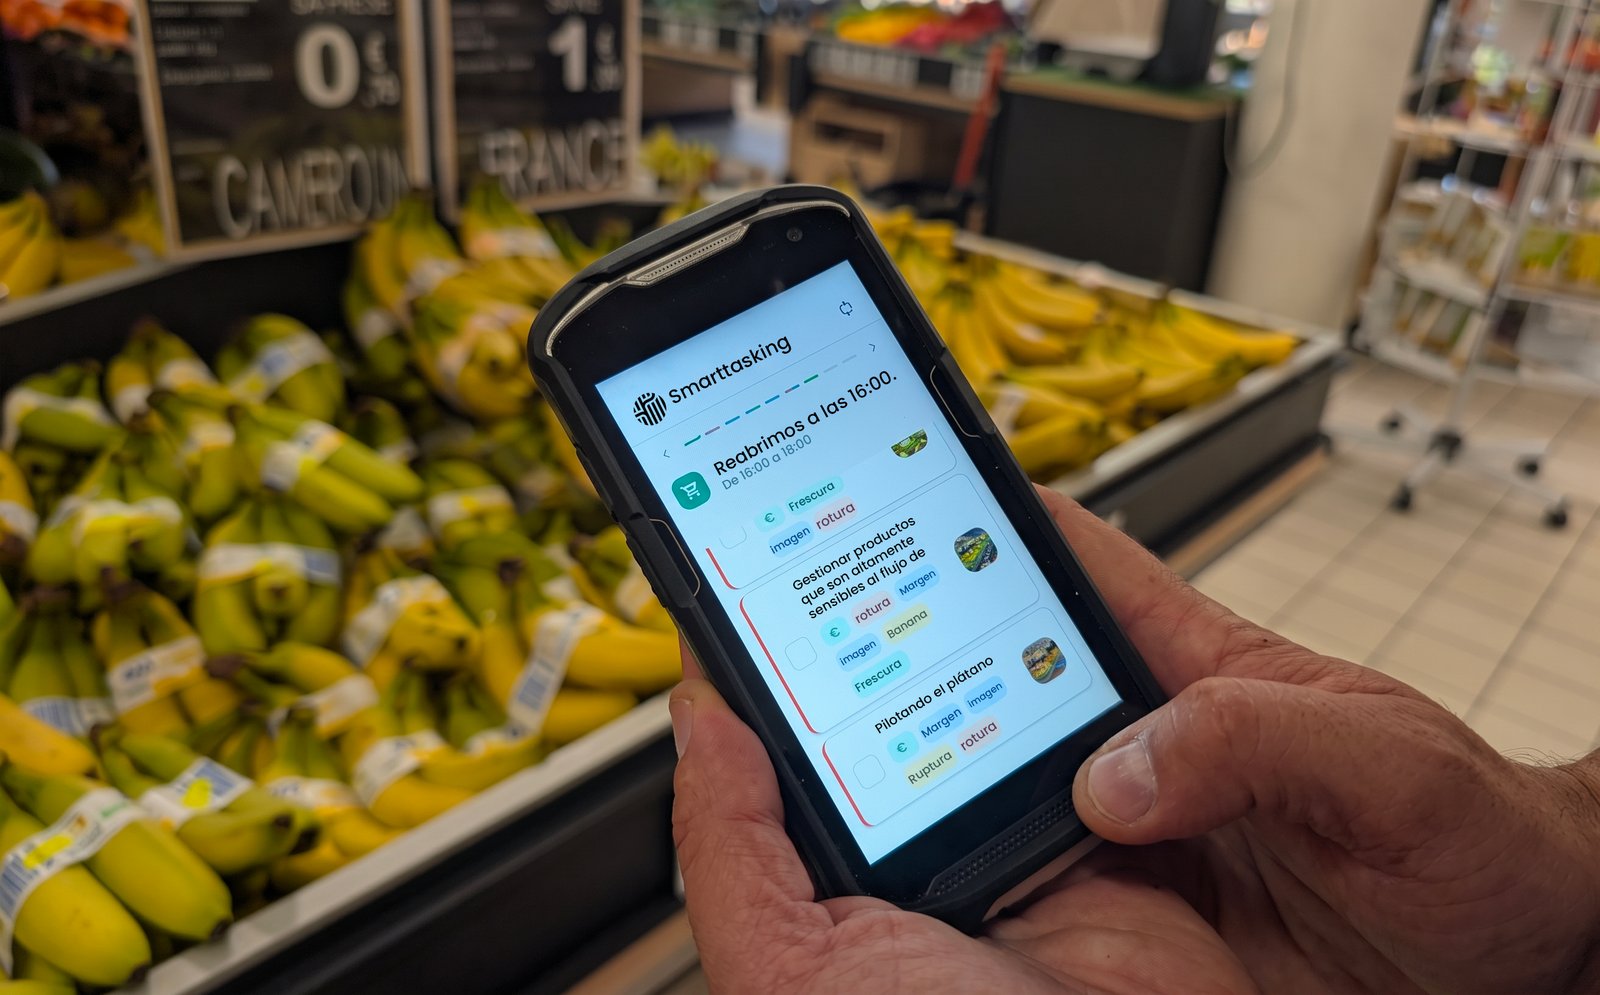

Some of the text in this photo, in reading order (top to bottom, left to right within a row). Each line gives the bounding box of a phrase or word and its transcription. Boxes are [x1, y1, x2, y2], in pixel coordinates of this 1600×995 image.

[296, 23, 360, 108] 0
[548, 17, 587, 92] 1
[668, 334, 792, 404] Smarttasking
[713, 370, 897, 476] Reabrimos a las 16:00.
[721, 434, 812, 490] De 16:00 a 18:00
[764, 481, 836, 523] € Frescura
[769, 502, 856, 554] imagen rotura
[792, 516, 916, 591] Gestionar productos
[801, 535, 915, 606] que son altamente
[808, 548, 926, 619] sensibles al flujo de
[829, 569, 937, 638] € rotura Margen
[839, 610, 928, 666] imagen Banana
[854, 659, 902, 692] Frescura
[874, 656, 994, 734] Pilotando el plátano
[896, 681, 1003, 753] € Margen imagen
[907, 721, 998, 785] Ruptura rotura
